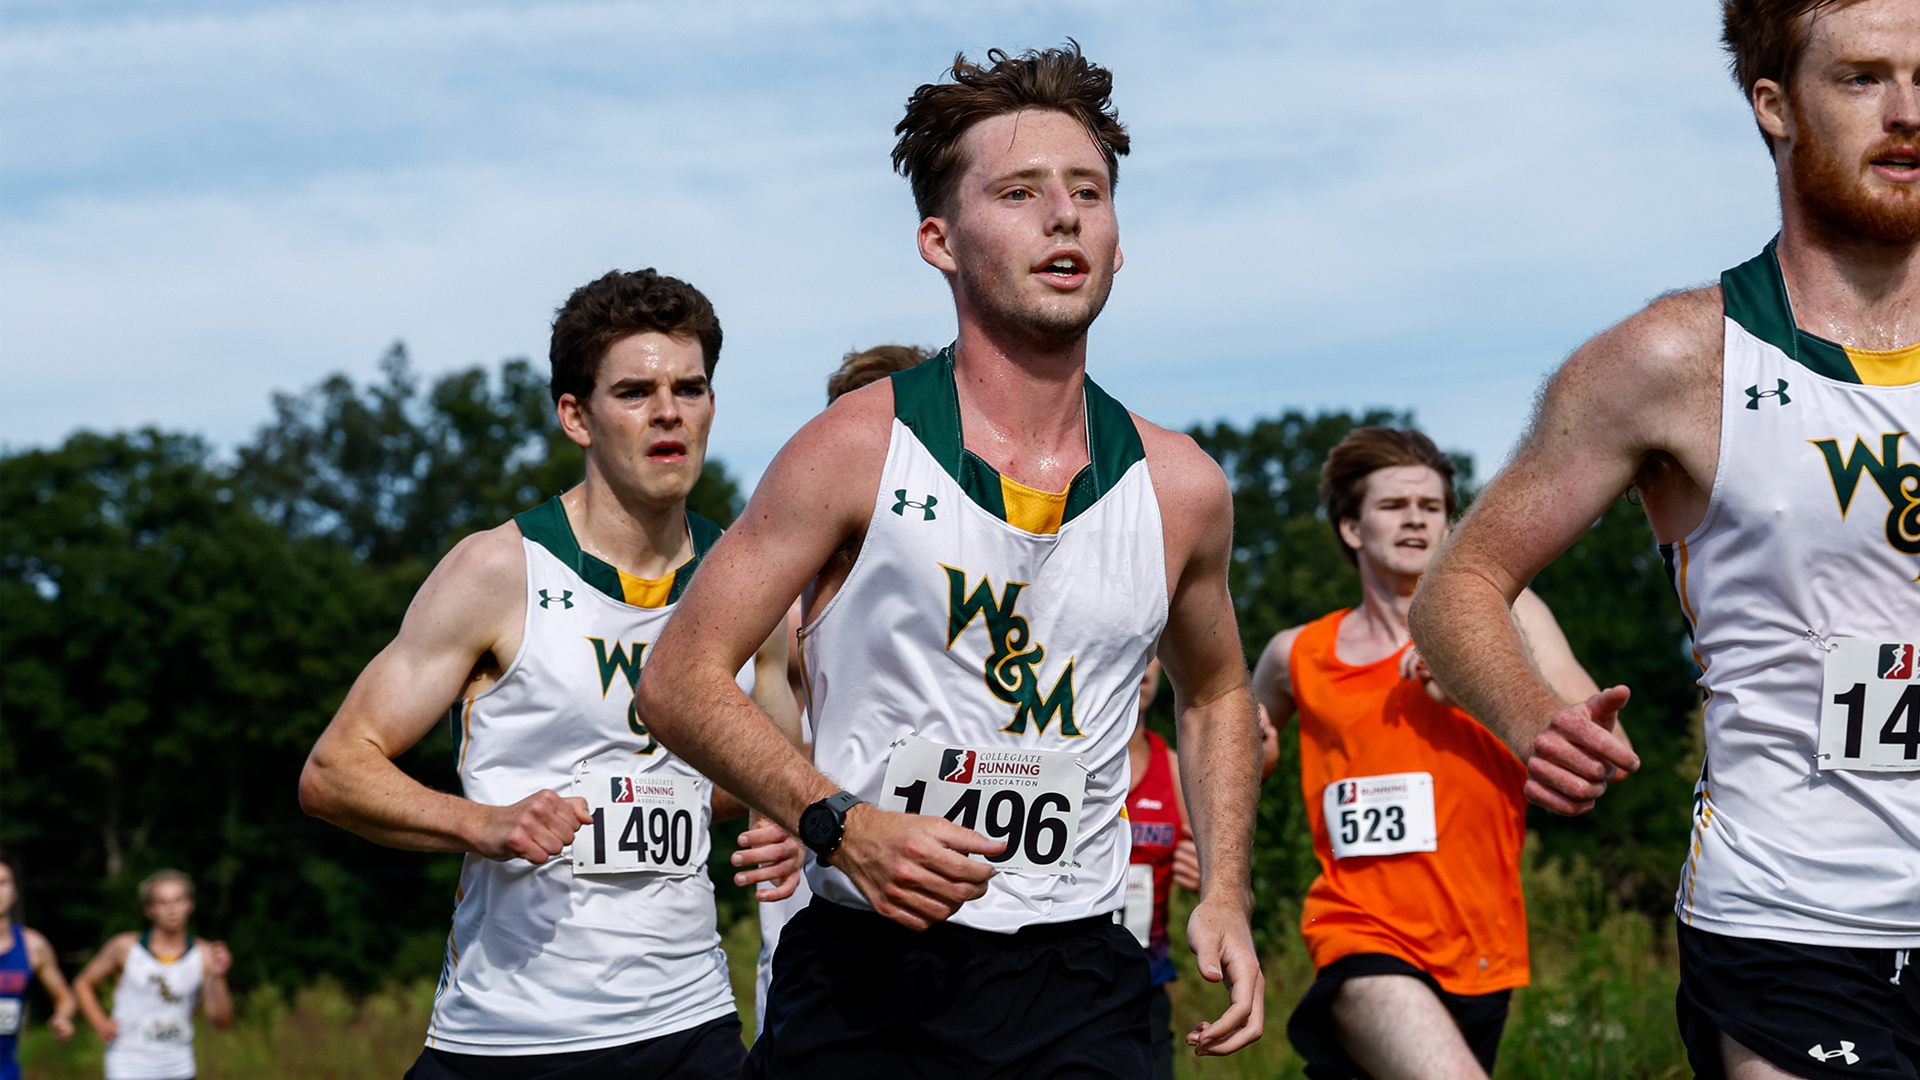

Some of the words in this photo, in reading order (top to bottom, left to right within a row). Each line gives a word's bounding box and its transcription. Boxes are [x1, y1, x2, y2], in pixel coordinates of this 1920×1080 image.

[936, 562, 1086, 738] W&M
[980, 753, 1043, 764] COLLEGIATE
[978, 762, 1040, 776] RUNNING
[634, 778, 674, 786] COLLEGIATE
[976, 779, 1038, 787] ASSOCIATION
[635, 785, 674, 797] RUNNING
[1342, 806, 1405, 845] 523
[592, 806, 692, 867] 1490
